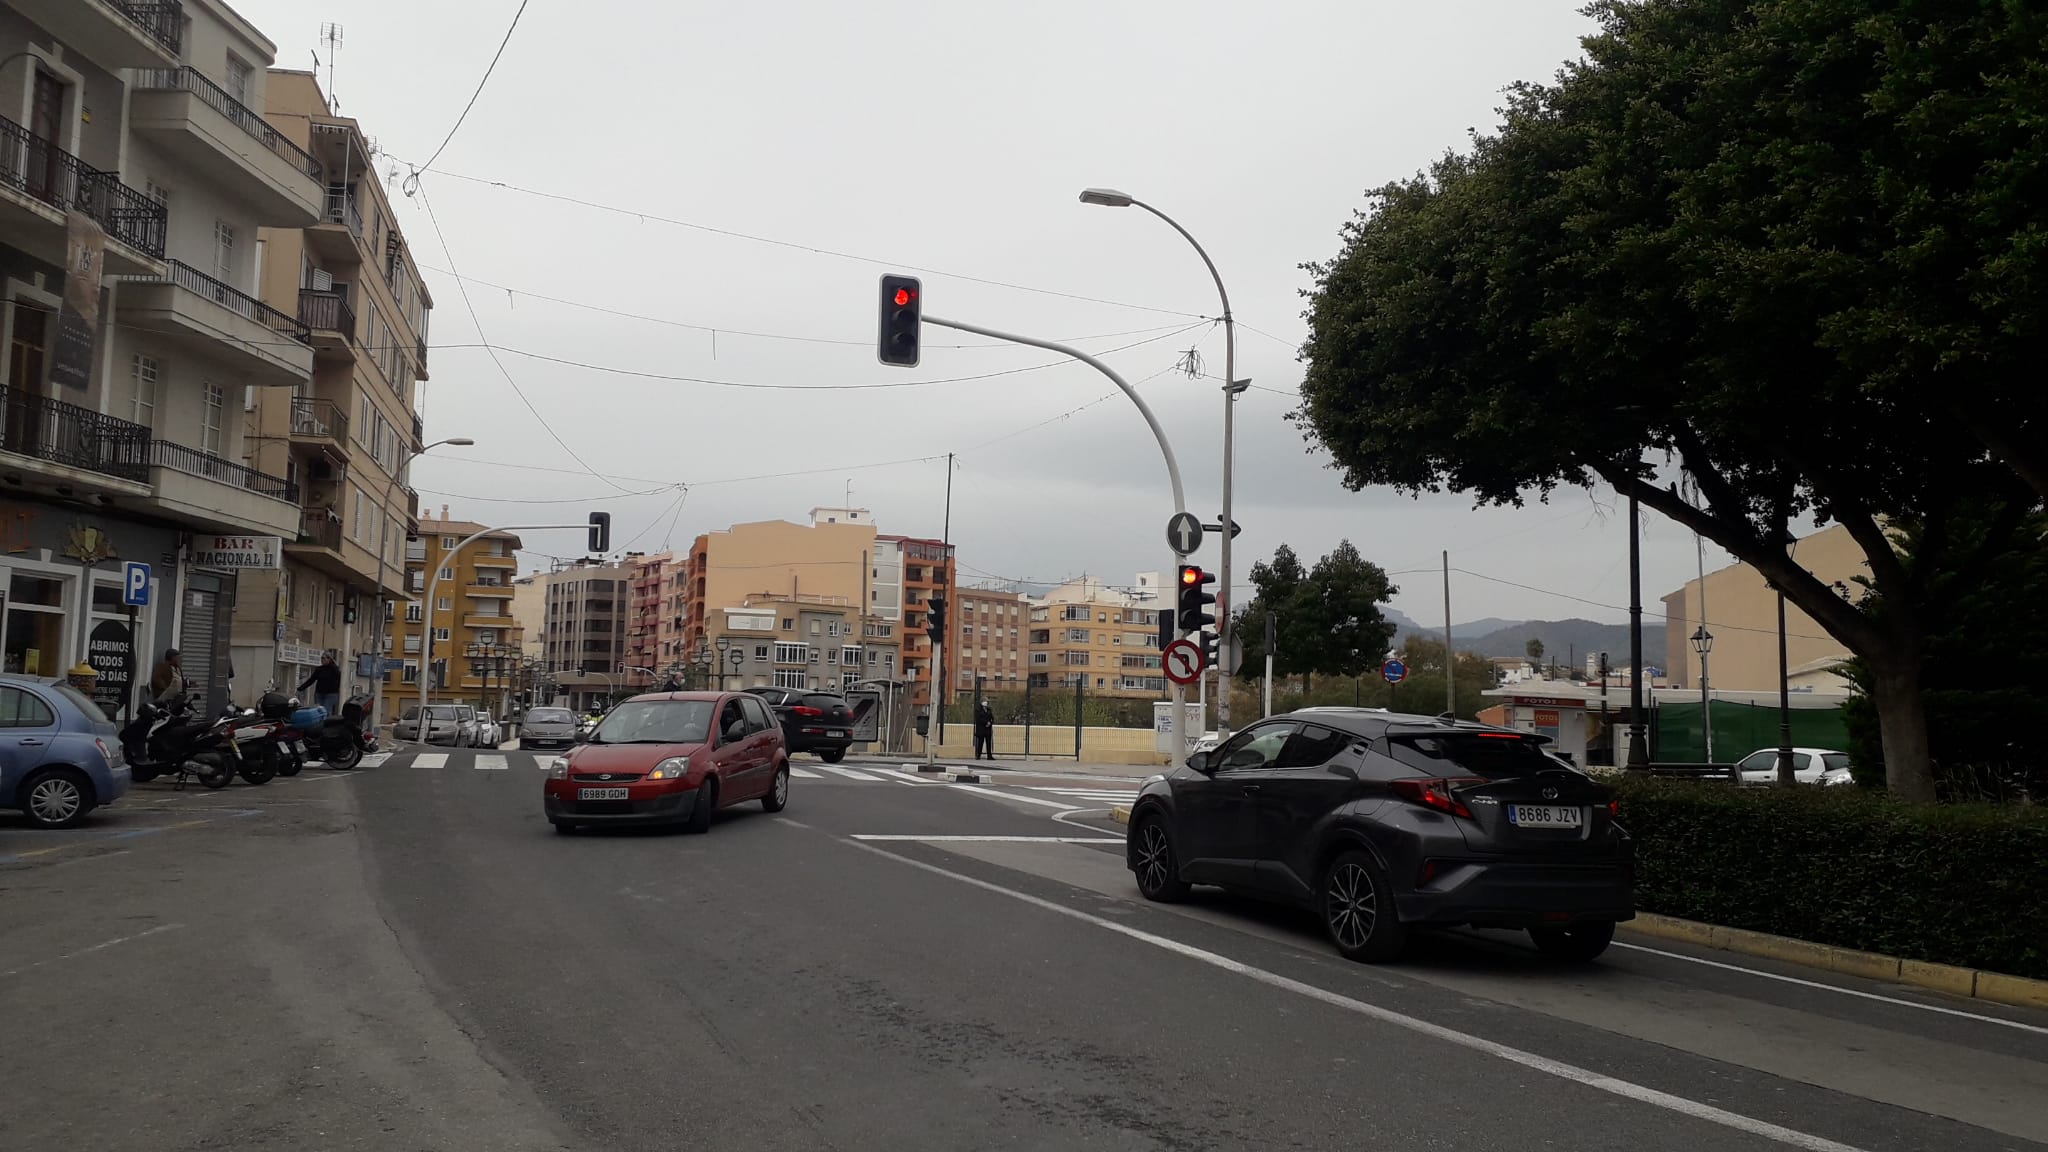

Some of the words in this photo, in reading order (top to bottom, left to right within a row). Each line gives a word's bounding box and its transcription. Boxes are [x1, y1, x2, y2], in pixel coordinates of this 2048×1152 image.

[214, 538, 254, 550] BAR
[196, 552, 260, 566] NACIONAL
[130, 568, 146, 600] P
[91, 640, 129, 653] ABRIMOS
[93, 655, 124, 667] TODOS
[108, 669, 128, 682] DÍAS
[584, 789, 606, 799] 6989
[609, 789, 626, 798] GDH
[1519, 807, 1552, 822] 8686
[1556, 808, 1578, 823] JZV
